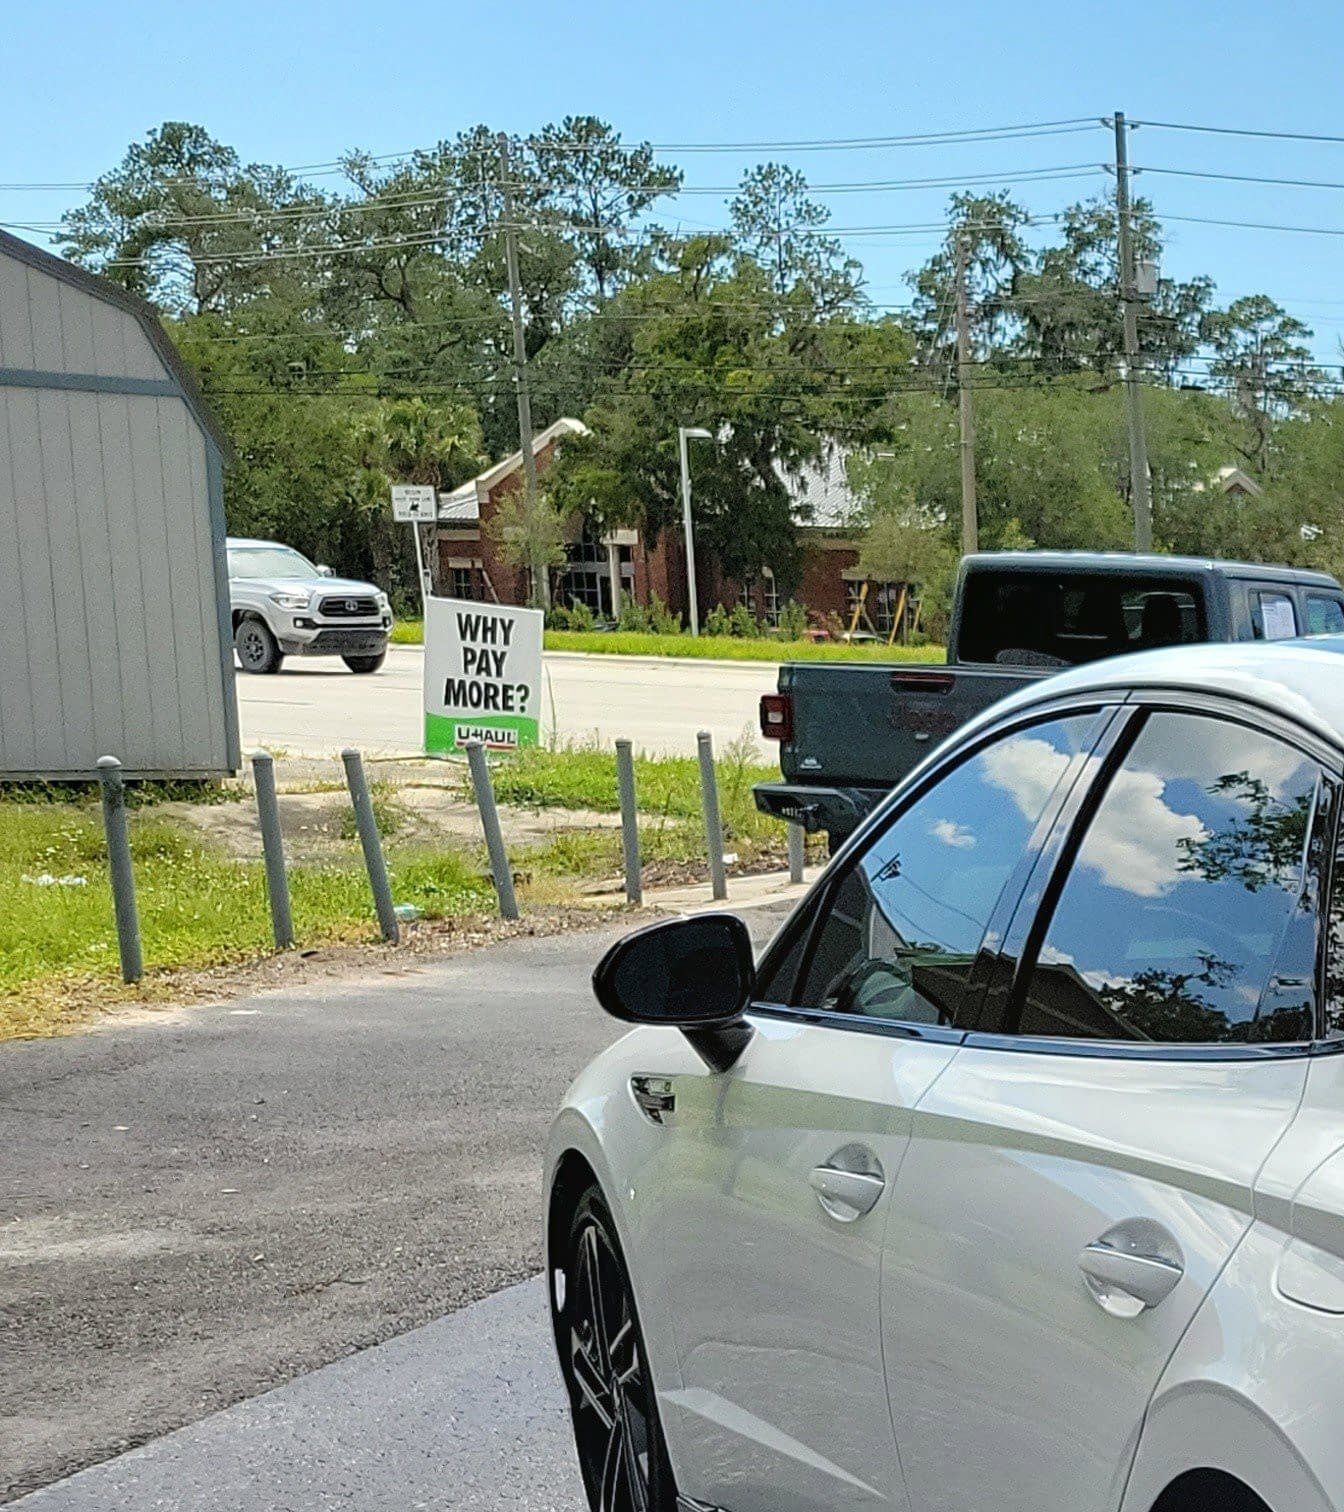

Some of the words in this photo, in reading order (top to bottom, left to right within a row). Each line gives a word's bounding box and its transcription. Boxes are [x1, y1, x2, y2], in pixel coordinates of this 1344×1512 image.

[457, 612, 514, 646] WHY
[463, 647, 507, 678] PAY
[444, 677, 530, 713] MORE?
